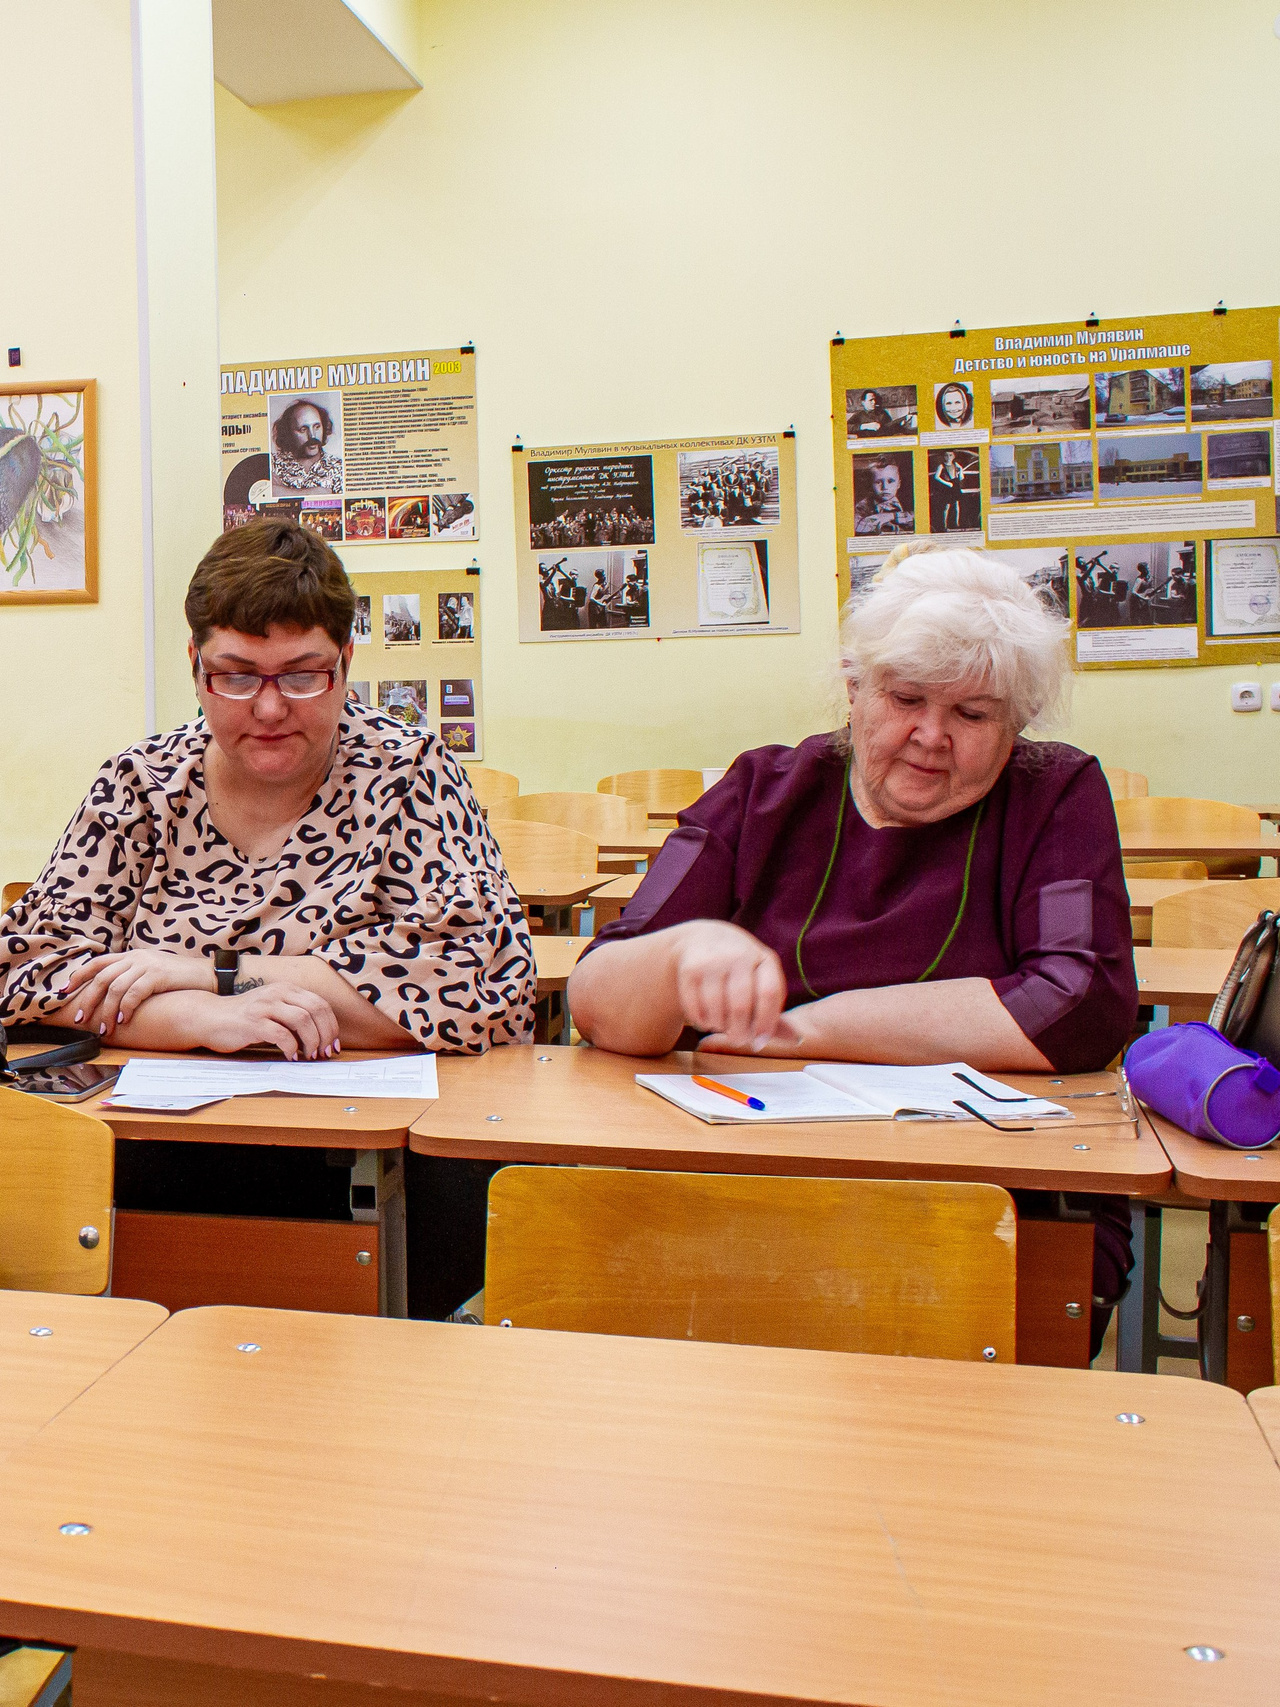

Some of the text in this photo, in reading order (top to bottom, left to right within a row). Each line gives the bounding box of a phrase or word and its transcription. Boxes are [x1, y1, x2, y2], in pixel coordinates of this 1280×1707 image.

[994, 328, 1144, 352] Владимир Мулявин
[953, 343, 1191, 375] Детство и юность на Уралмаше
[220, 358, 462, 396] ЛАДИМИР МУЛЯВИН 2003
[530, 449, 572, 457] Владимир
[574, 446, 612, 456] Мулявин
[620, 441, 678, 453] музыкальных
[680, 438, 735, 449] коллективах
[736, 436, 749, 446] ДК
[750, 435, 776, 445] УЗТМ
